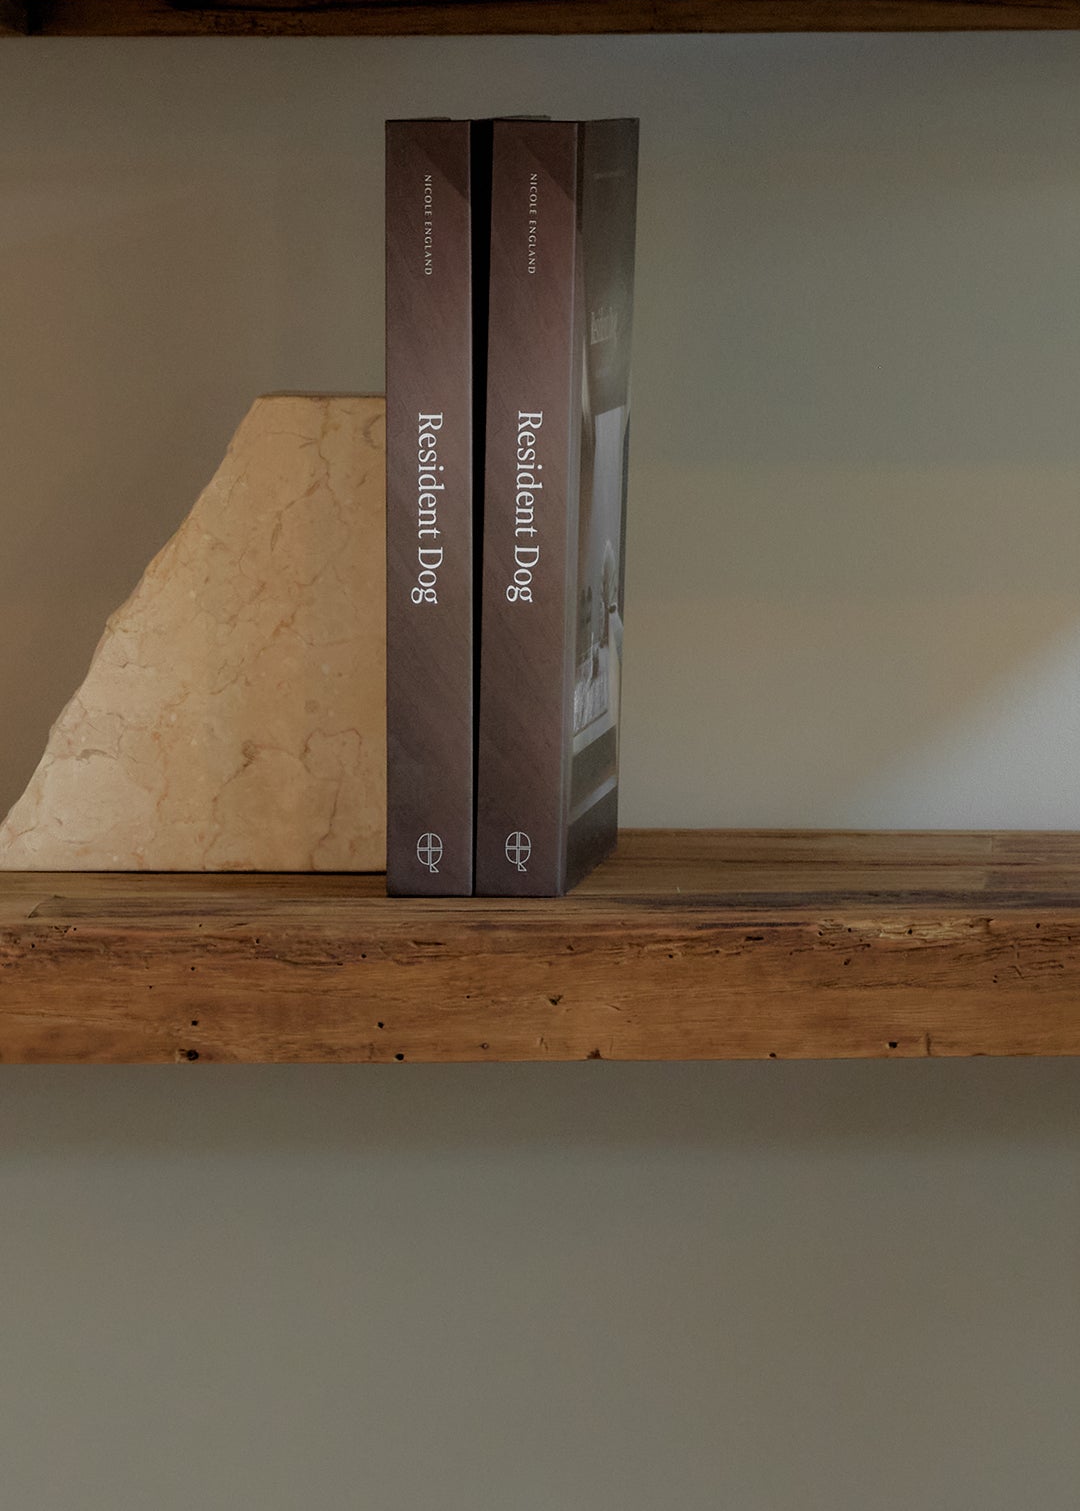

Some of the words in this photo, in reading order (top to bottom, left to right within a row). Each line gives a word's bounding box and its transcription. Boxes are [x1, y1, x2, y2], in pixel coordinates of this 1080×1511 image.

[424, 174, 433, 216] NICOLE
[528, 173, 538, 215] NICOLE
[424, 221, 433, 276] ENGLAND
[527, 220, 537, 274] ENGLAND
[417, 411, 446, 540] Resident
[514, 409, 544, 538] Resident
[410, 546, 444, 605] Dog
[505, 544, 540, 603] Dog
